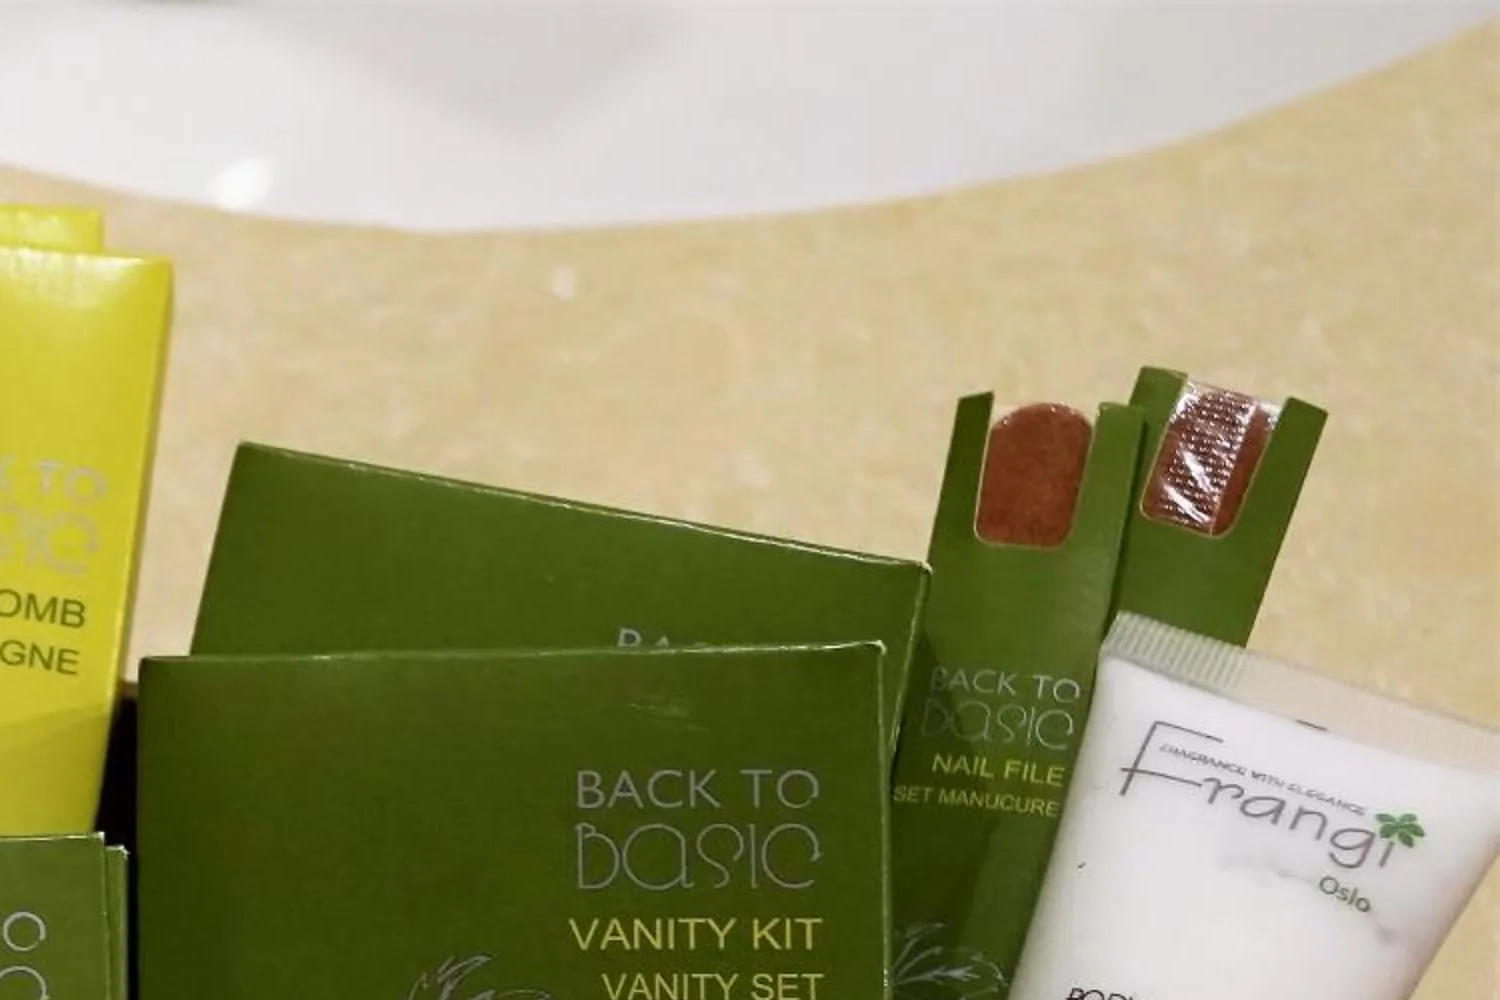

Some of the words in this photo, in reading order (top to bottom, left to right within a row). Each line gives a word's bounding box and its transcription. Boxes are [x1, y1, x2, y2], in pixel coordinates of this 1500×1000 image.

[36, 458, 108, 506] TO
[931, 666, 1018, 697] BACK
[1033, 674, 1082, 703] TO
[932, 752, 995, 780] NAIL
[1004, 759, 1065, 788] FILE
[576, 769, 721, 809] BACK
[740, 769, 820, 809] TO
[893, 784, 936, 803] SET
[1120, 721, 1396, 869] Frangi
[1318, 875, 1371, 913] Oslo
[569, 917, 737, 950] VANITY
[752, 917, 823, 950] KIT
[602, 973, 739, 1000] VANITY
